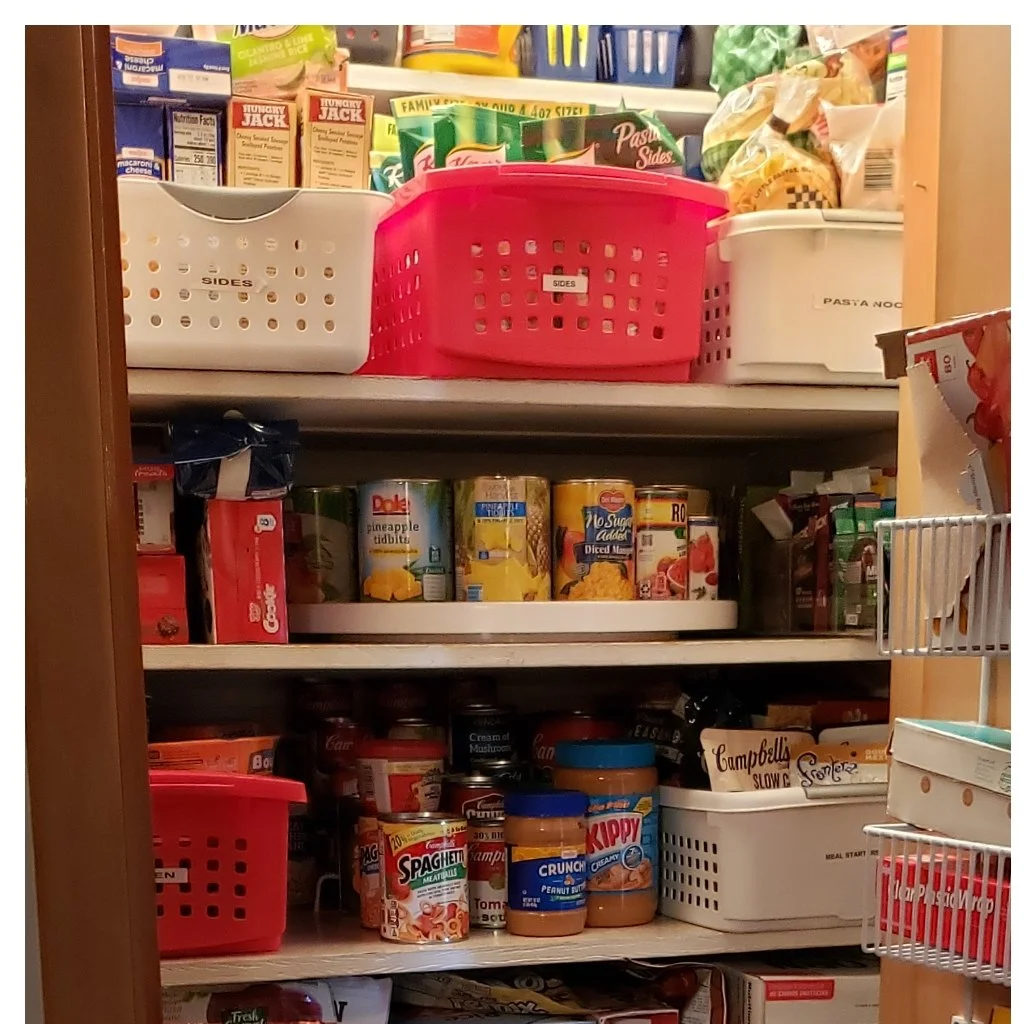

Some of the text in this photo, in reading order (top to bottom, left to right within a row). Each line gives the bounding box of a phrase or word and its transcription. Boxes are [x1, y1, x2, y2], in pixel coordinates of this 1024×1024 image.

[243, 104, 287, 118] HUNGRY
[320, 98, 363, 111] HUNGRY
[242, 114, 289, 129] JACK
[319, 107, 364, 123] JACK
[117, 159, 153, 171] macaroni
[201, 276, 254, 288] SIDES
[552, 279, 576, 289] SIDES
[823, 296, 870, 309] PASTA
[372, 493, 411, 513] Dole
[585, 511, 604, 530] No
[367, 521, 420, 538] pineapple
[595, 529, 629, 542] Added
[374, 531, 411, 545] tidbits
[584, 544, 611, 555] Diced
[469, 731, 501, 742] Cream
[712, 736, 791, 776] Campbell's
[752, 772, 778, 790] SLOW
[590, 852, 621, 873] CREAMY
[825, 849, 879, 862] MEAL STARTRS
[538, 860, 587, 878] CRUNCH
[541, 884, 570, 896] PEANUT
[230, 1008, 260, 1023] Fresh
